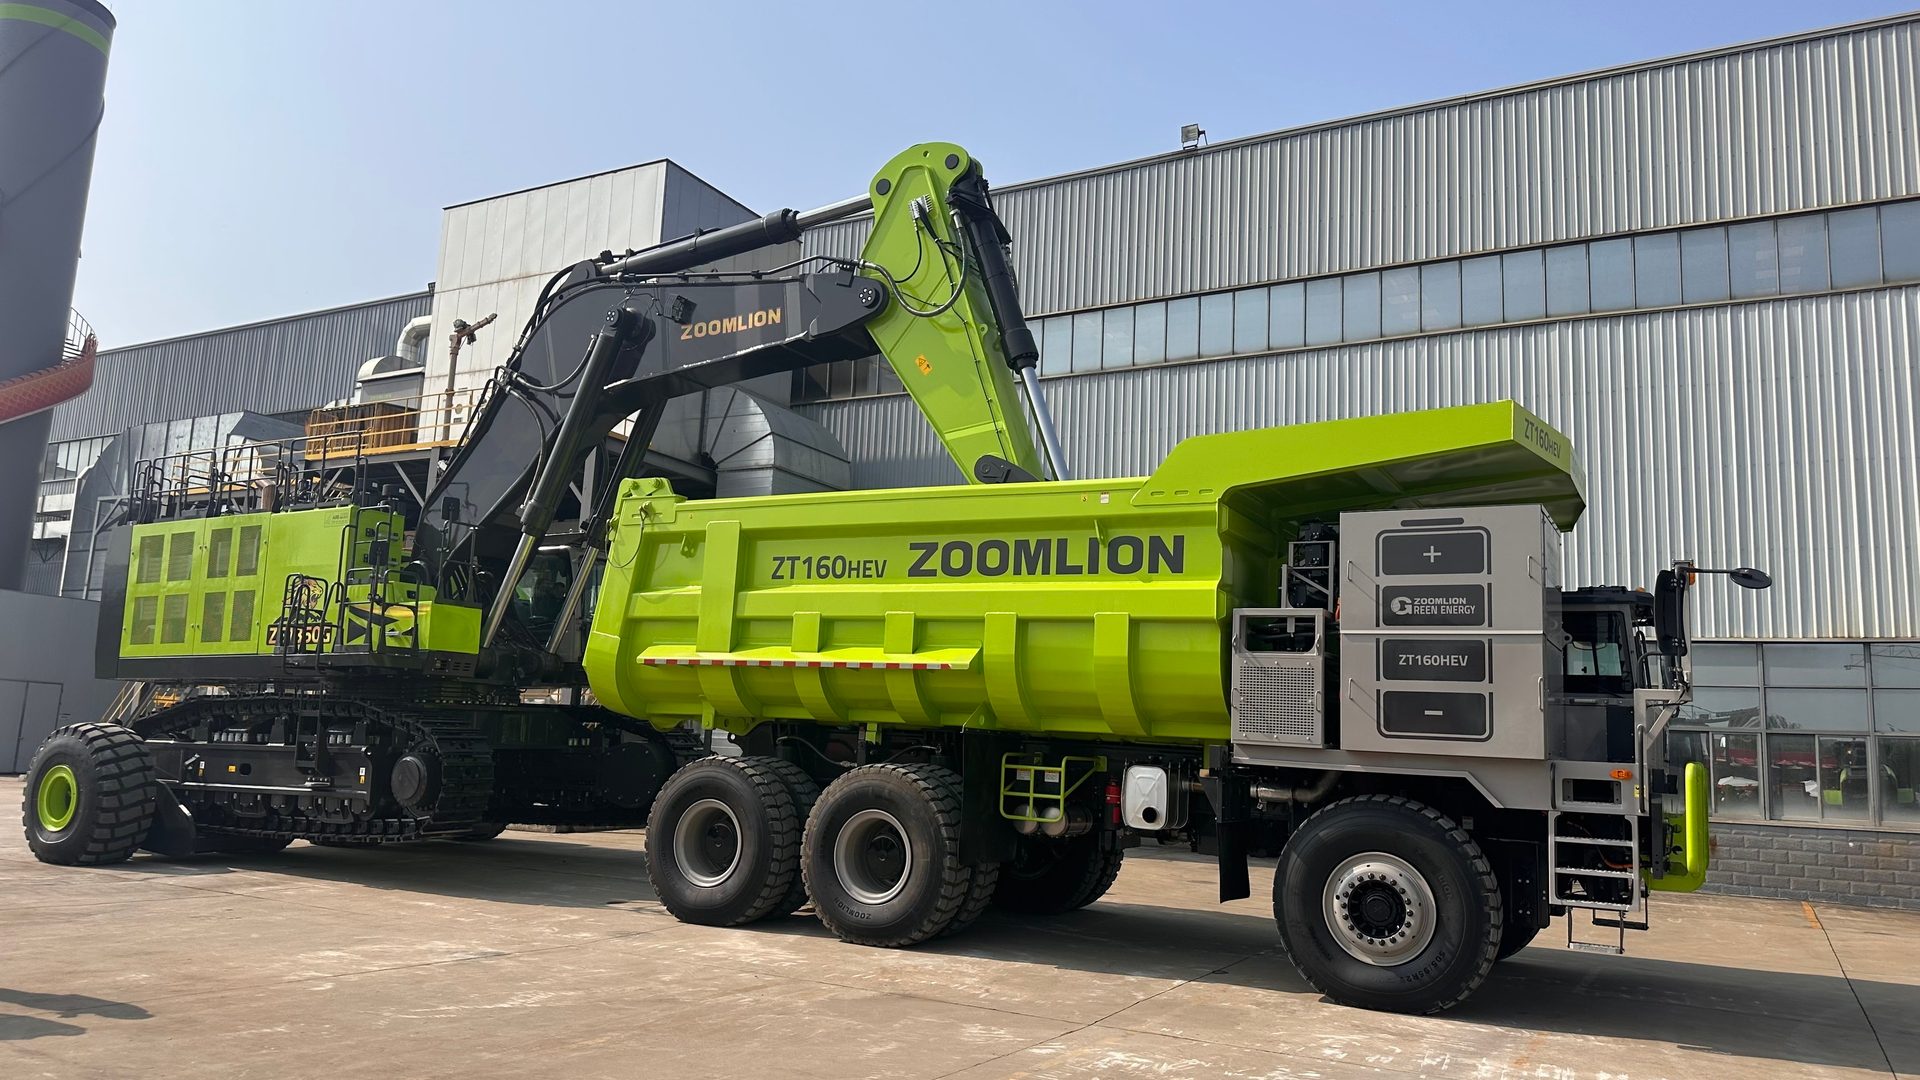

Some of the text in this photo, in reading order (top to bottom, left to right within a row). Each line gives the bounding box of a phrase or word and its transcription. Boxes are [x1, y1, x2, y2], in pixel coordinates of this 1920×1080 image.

[681, 307, 781, 340] ZOOMLION
[1524, 418, 1561, 459] ZT160HEV
[771, 535, 1184, 580] ZT160HEV ZOOMLION
[1414, 597, 1467, 605] ZOOMLION
[1440, 605, 1475, 615] ENERGY
[1398, 654, 1468, 666] ZT160HEV
[833, 896, 872, 920] ZOOMLION
